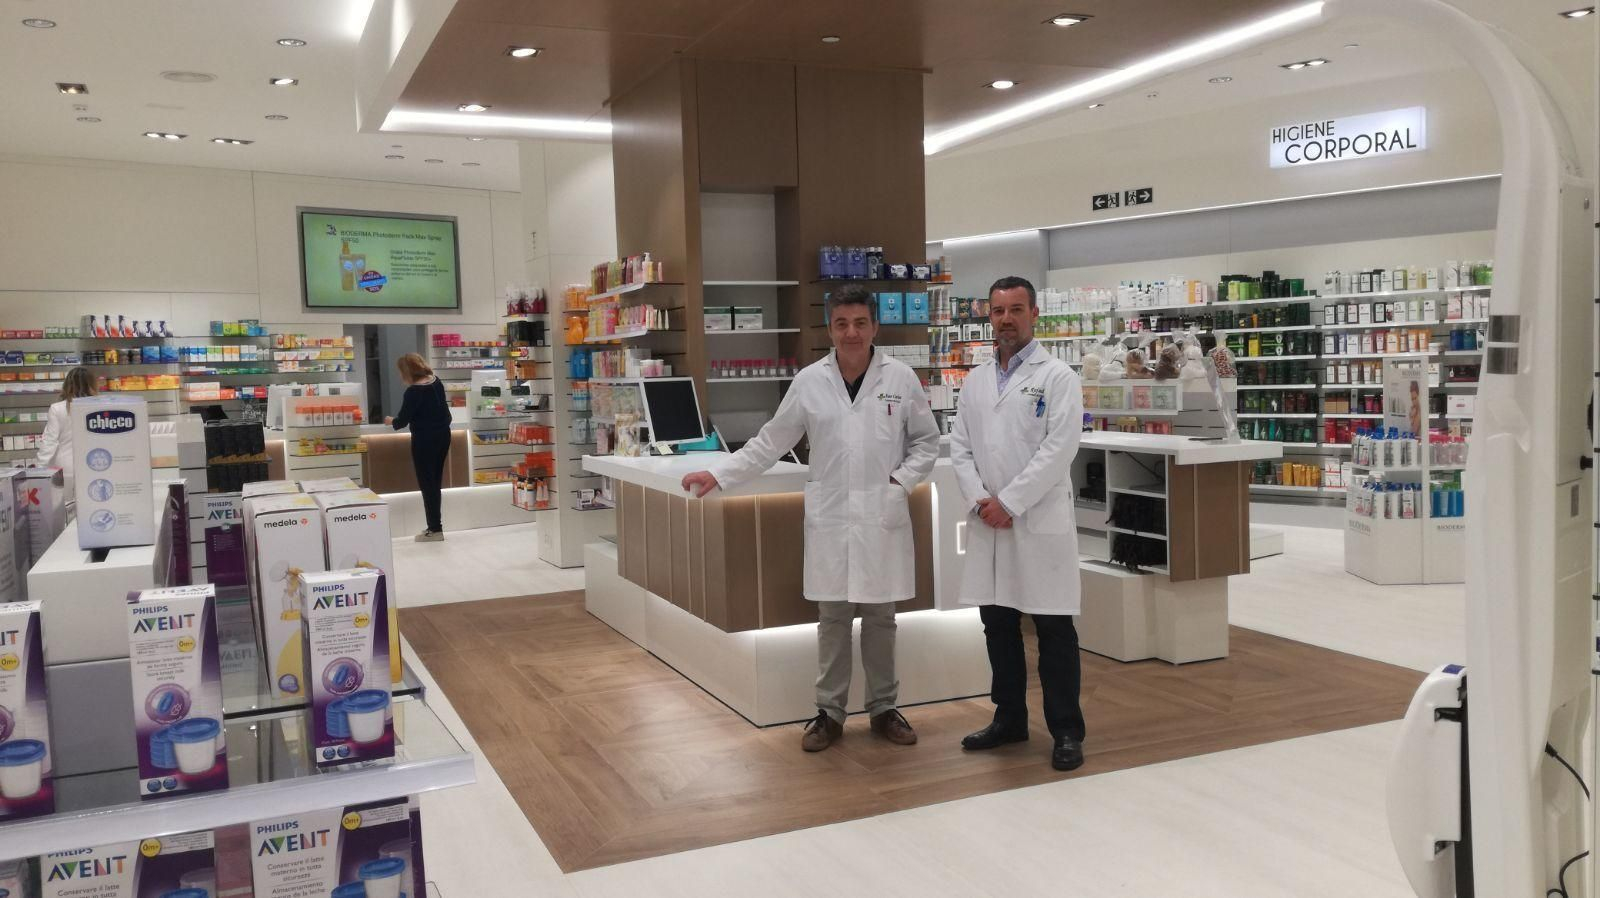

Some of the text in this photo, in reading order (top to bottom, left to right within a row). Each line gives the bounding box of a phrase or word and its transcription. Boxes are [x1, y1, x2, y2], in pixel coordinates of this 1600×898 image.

[1272, 121, 1335, 143] HIGIENE
[1285, 128, 1416, 163] CORPORAL
[89, 411, 133, 429] chicco
[208, 509, 243, 521] AVEN
[334, 513, 367, 523] medela
[264, 518, 298, 528] medela
[312, 584, 345, 592] PHILIPS
[313, 592, 369, 610] AVENT
[132, 605, 169, 615] PHILIPS
[133, 613, 195, 633] AVENT
[257, 821, 298, 834] PHILIPS
[258, 829, 330, 857] AVENT
[47, 855, 127, 882] AVENT
[267, 860, 303, 870] Conservare
[57, 887, 97, 896] Conservare
